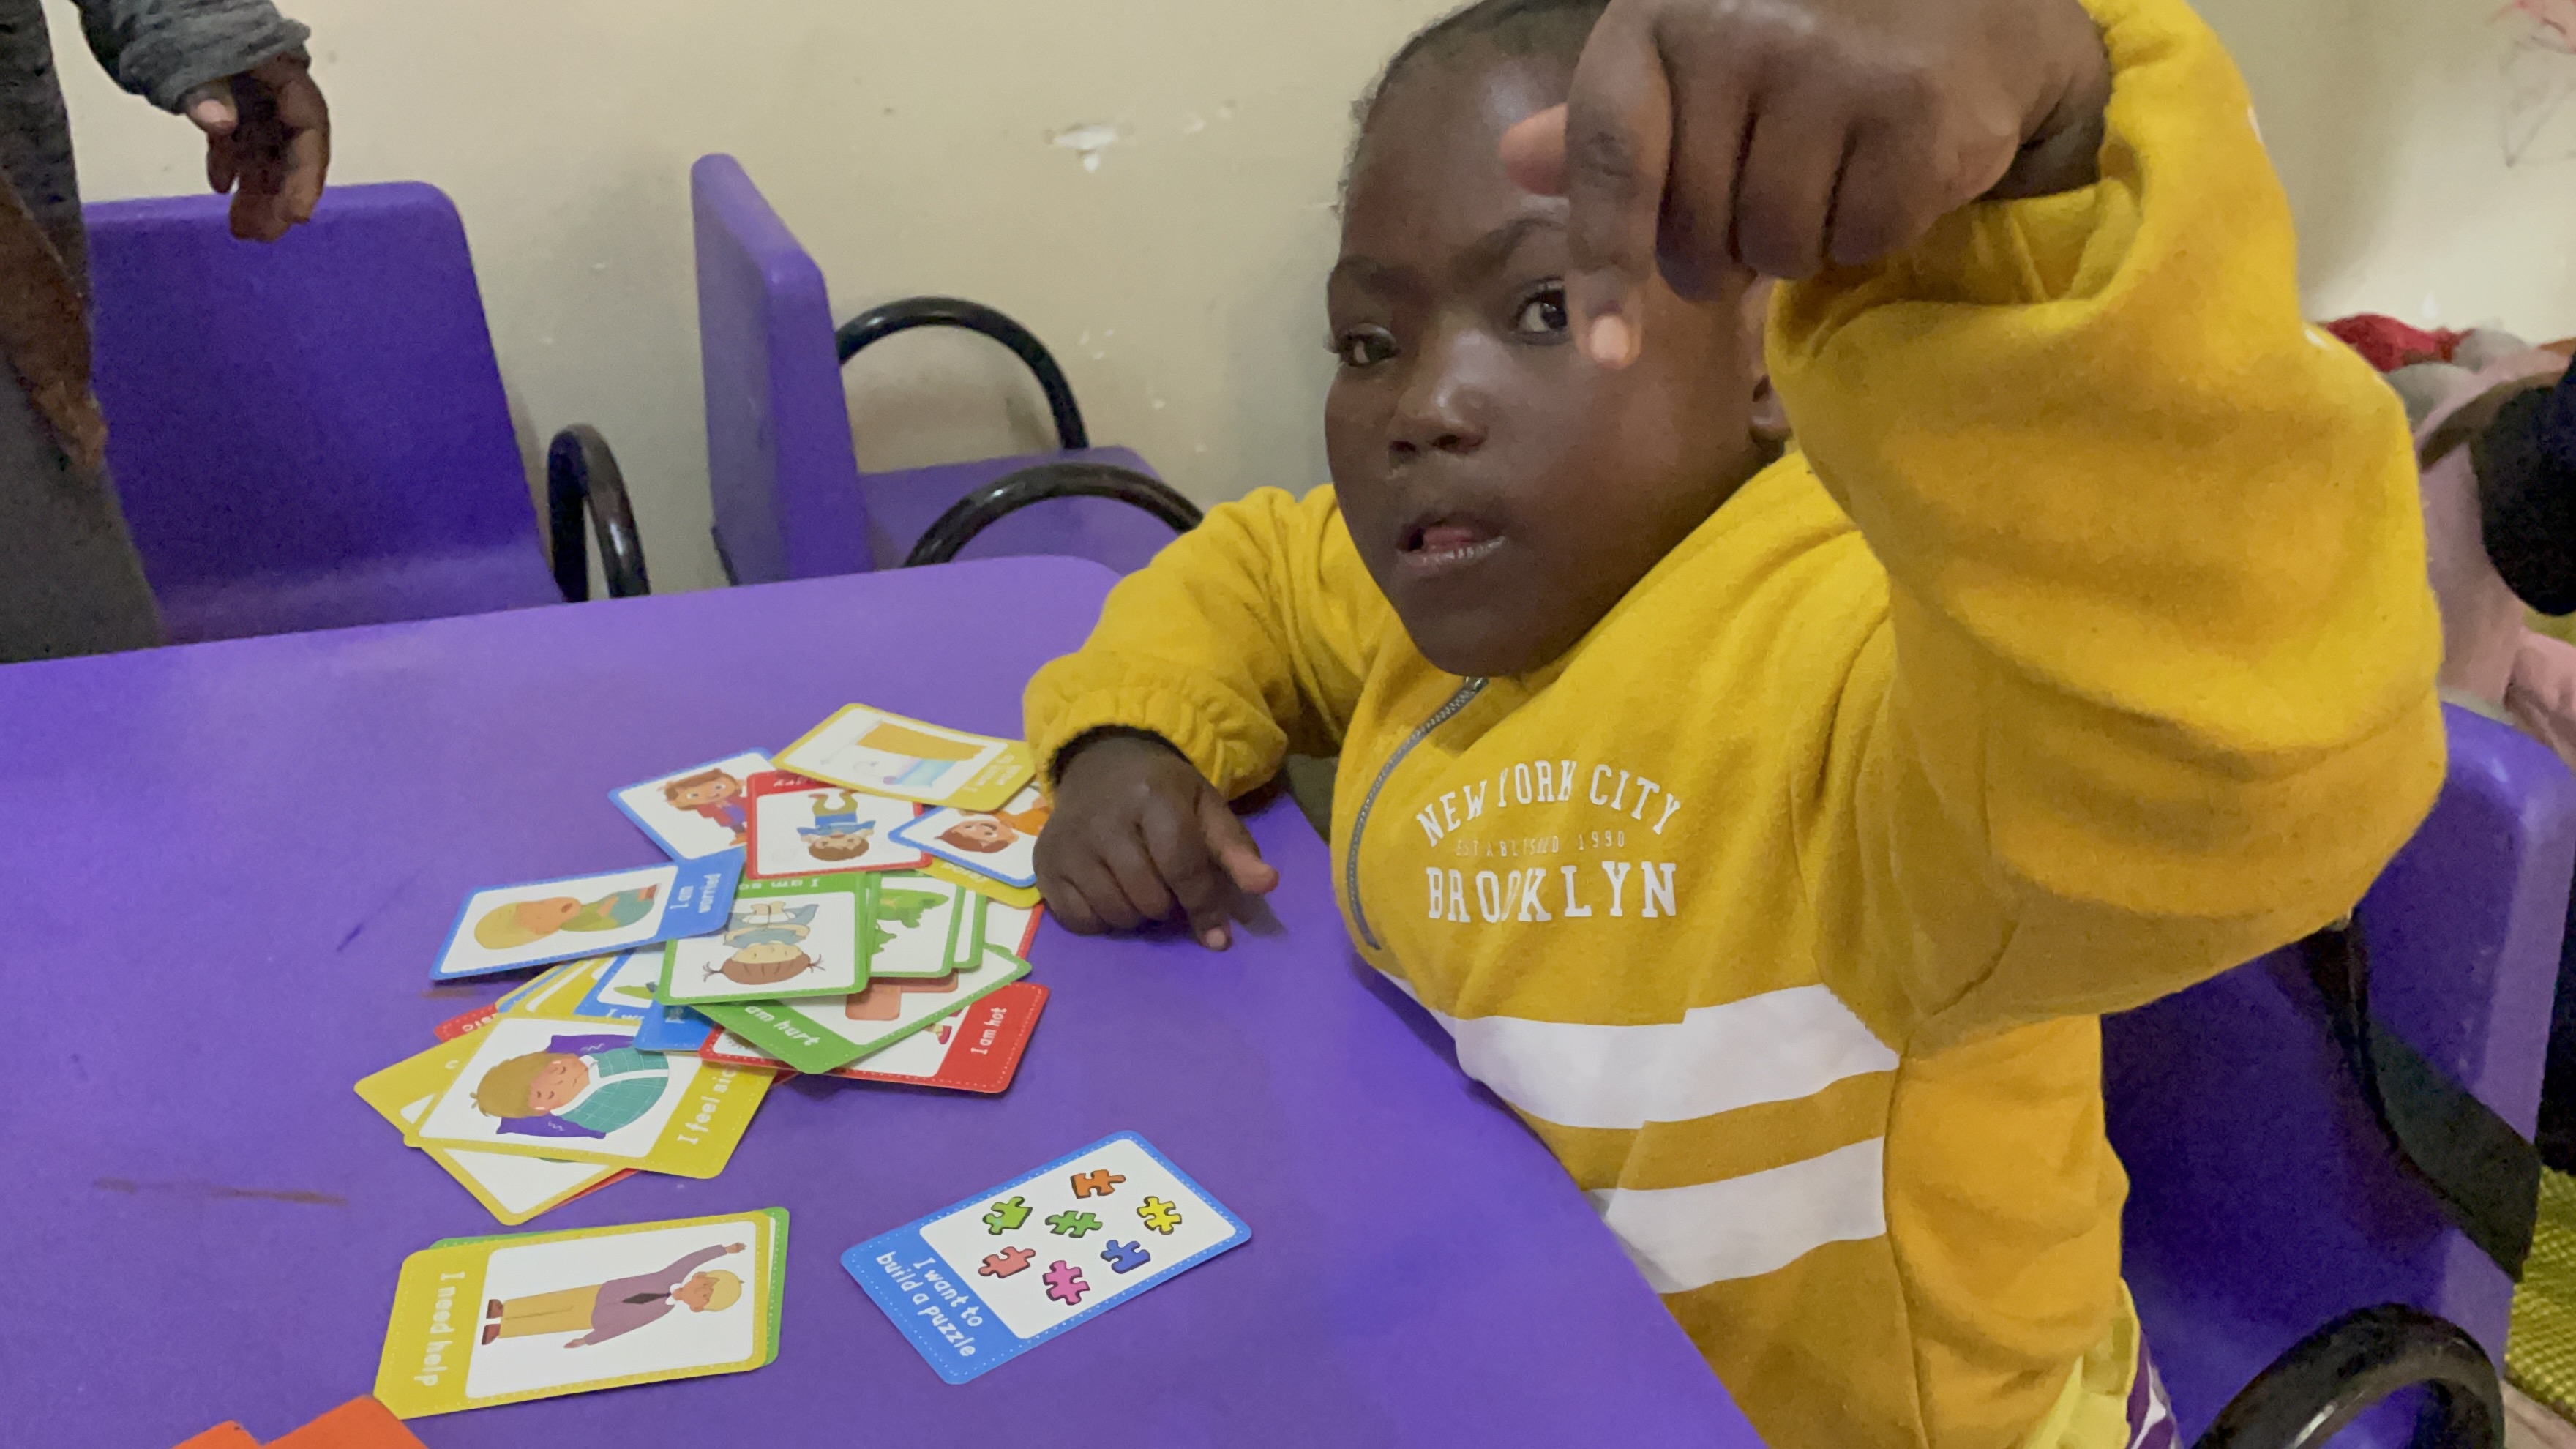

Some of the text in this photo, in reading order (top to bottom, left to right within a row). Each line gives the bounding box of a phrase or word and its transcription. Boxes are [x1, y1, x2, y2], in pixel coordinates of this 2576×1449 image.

[1416, 779, 1487, 847] NEW
[1589, 764, 1681, 835] CITY
[745, 1006, 820, 1046] am hurt
[984, 1007, 1007, 1027] hot
[979, 1029, 997, 1047] am
[685, 1096, 721, 1133] feel
[676, 1134, 699, 1145] I
[875, 1251, 976, 1357] build a puzzle
[913, 1257, 984, 1327] I want to
[413, 1271, 465, 1387] I need help
